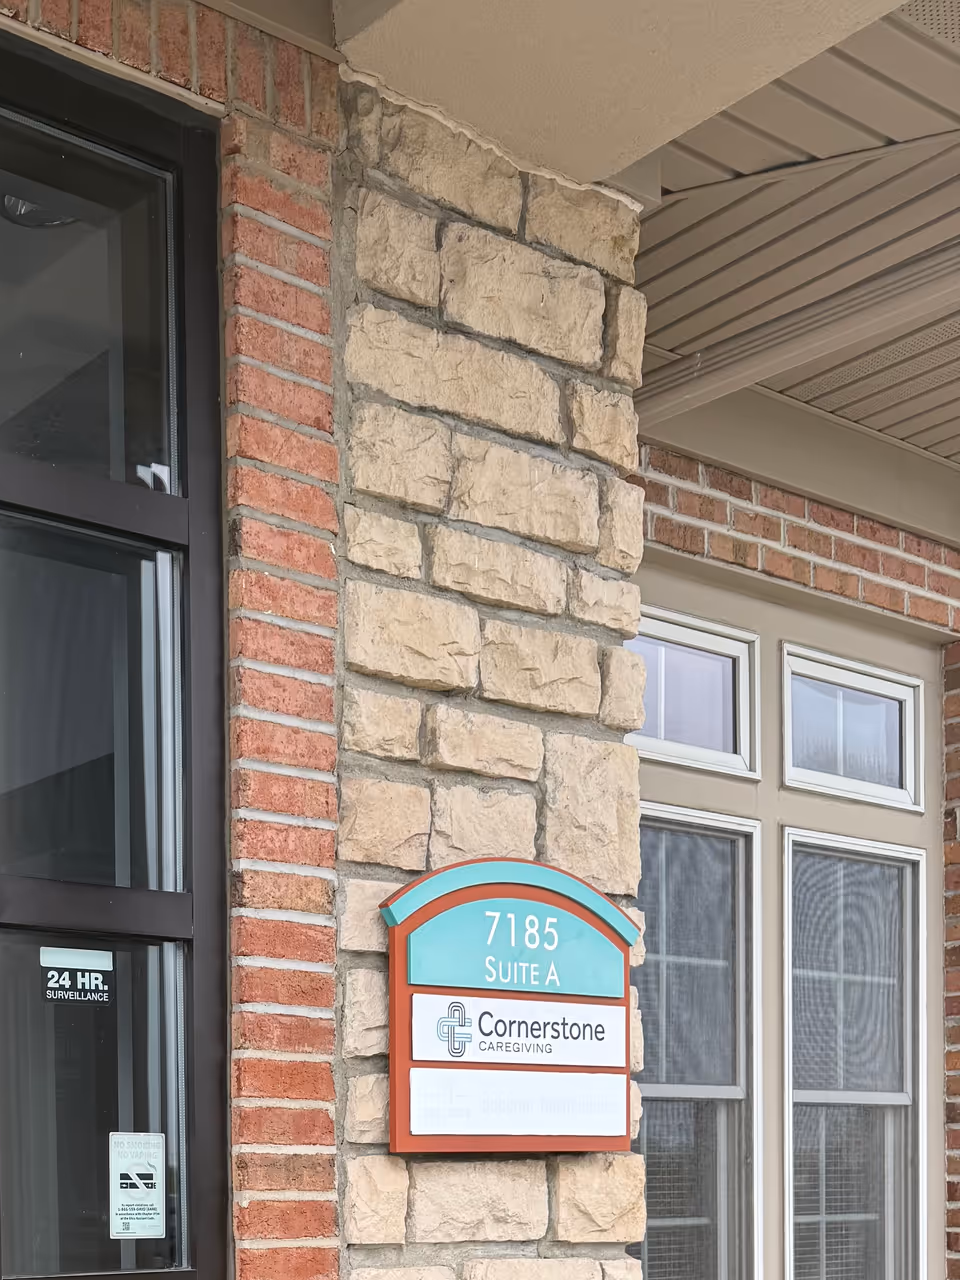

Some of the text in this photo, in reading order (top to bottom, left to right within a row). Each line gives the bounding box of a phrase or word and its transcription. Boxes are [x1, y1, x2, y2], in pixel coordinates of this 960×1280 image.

[485, 911, 559, 951] 7185
[47, 970, 109, 991] 24 HR.
[485, 956, 560, 987] SUITE A
[45, 989, 109, 1002] SURVEILLANCE
[478, 1011, 605, 1042] Cornerstone
[478, 1041, 553, 1054] CAREGIVING
